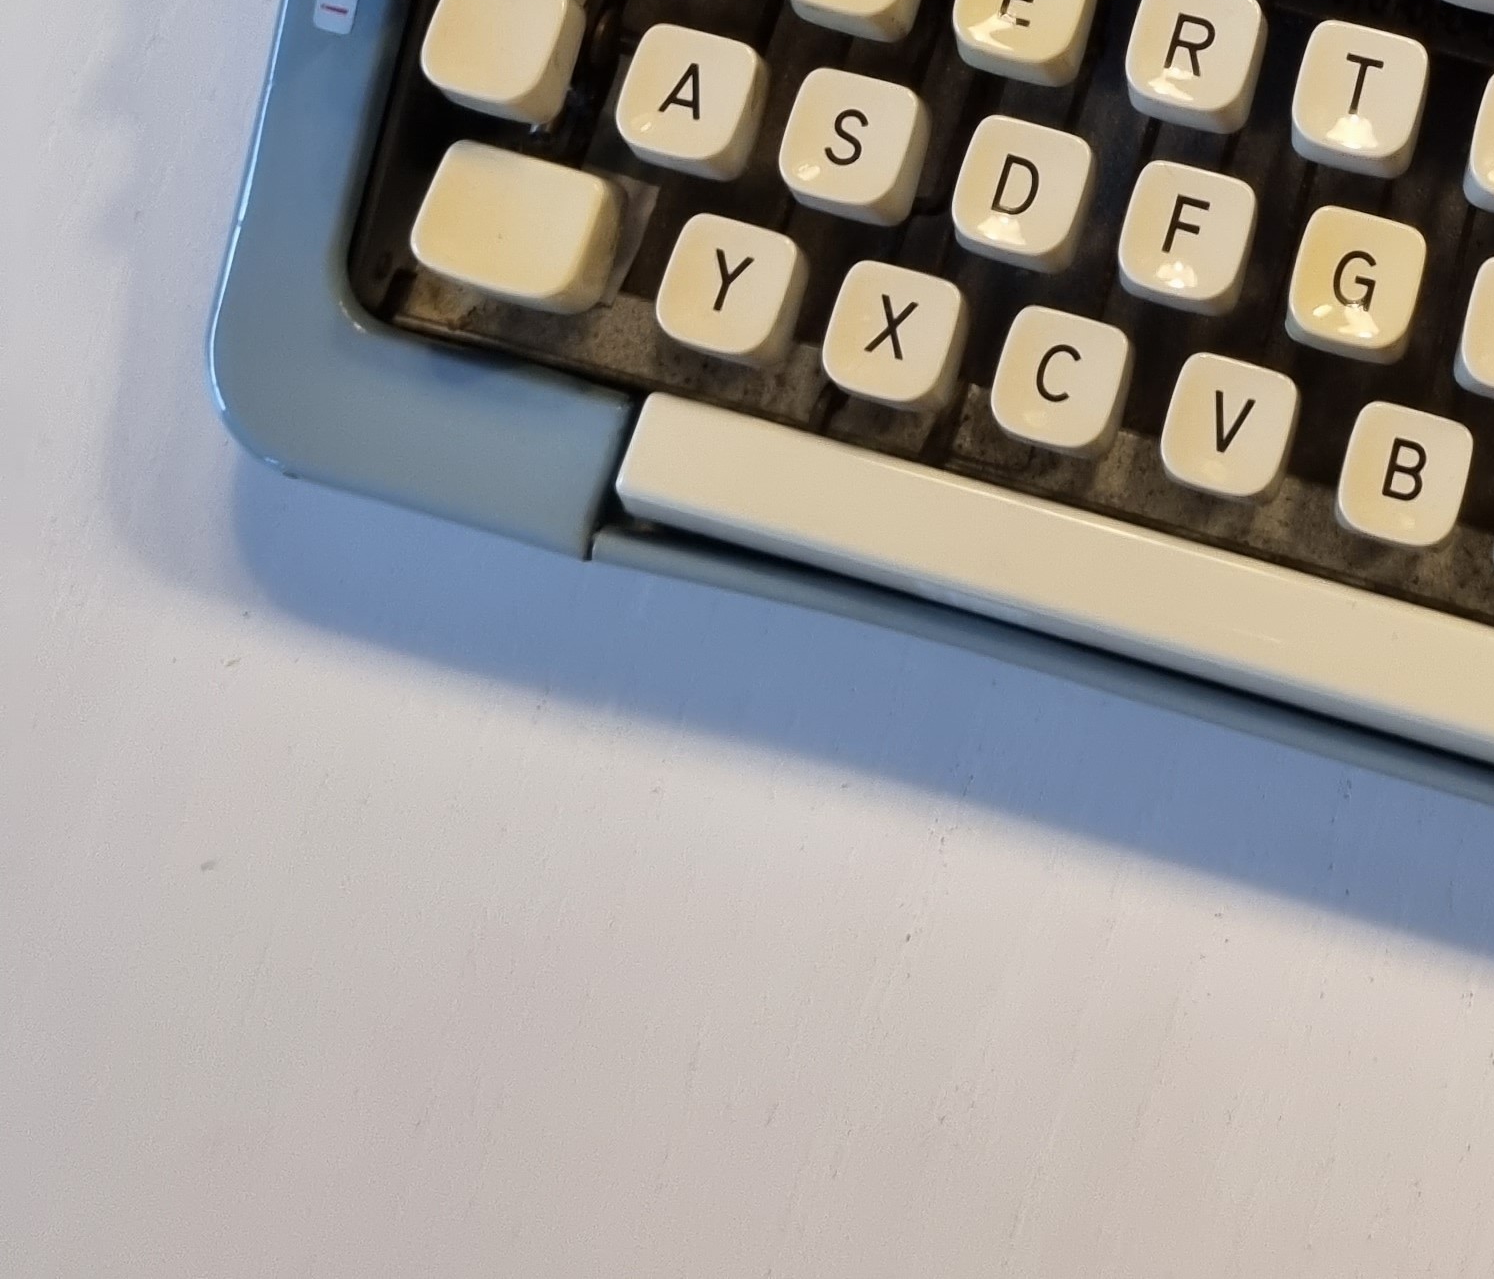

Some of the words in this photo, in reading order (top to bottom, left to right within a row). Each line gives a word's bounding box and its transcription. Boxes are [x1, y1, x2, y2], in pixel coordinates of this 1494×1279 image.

[1164, 13, 1215, 76] R
[659, 63, 700, 120] A
[1347, 53, 1384, 114] T
[825, 109, 868, 165] S
[991, 154, 1039, 215] D
[1162, 194, 1210, 253] F
[713, 249, 754, 311] Y
[1333, 251, 1376, 311] G
[865, 294, 918, 360] X
[1036, 345, 1081, 402] C
[1216, 390, 1255, 453] V
[1382, 438, 1426, 501] B
